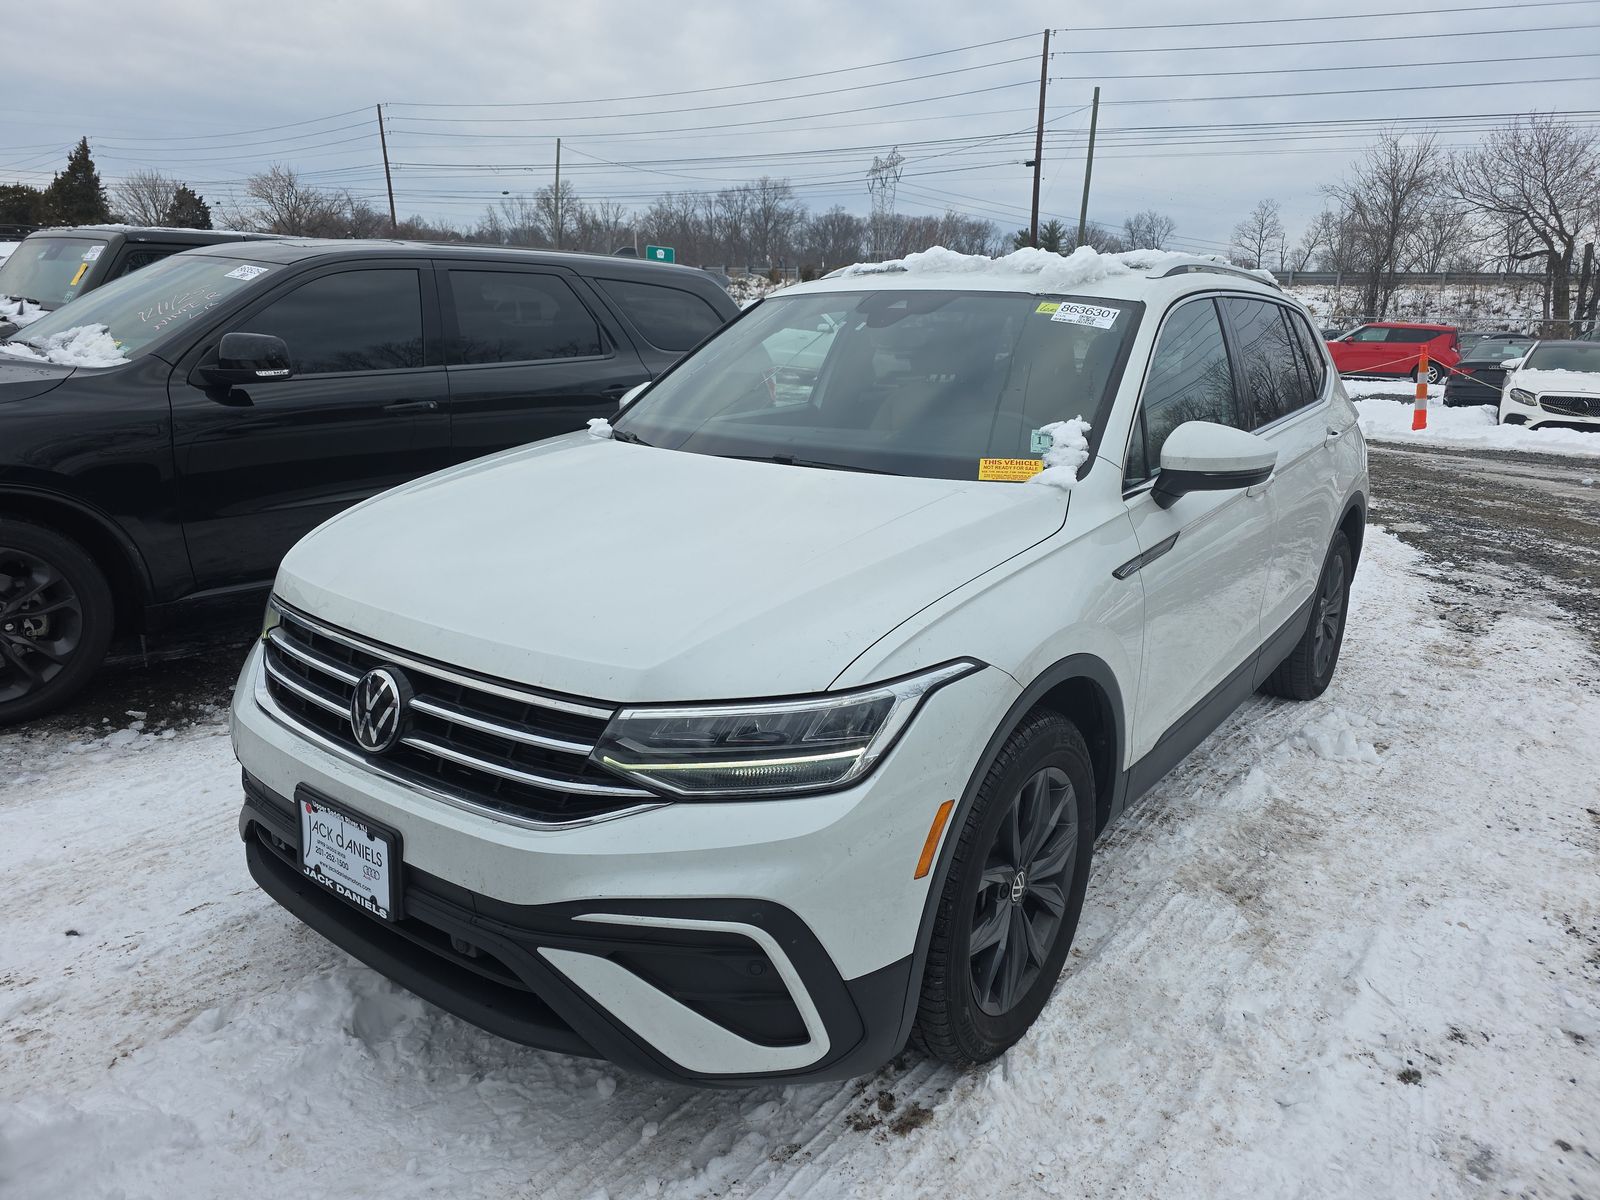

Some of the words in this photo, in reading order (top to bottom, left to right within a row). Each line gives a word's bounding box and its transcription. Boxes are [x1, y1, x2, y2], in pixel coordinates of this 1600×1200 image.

[1060, 304, 1118, 319] 8636301
[303, 867, 334, 890] JACK
[336, 883, 388, 919] DANIELS
